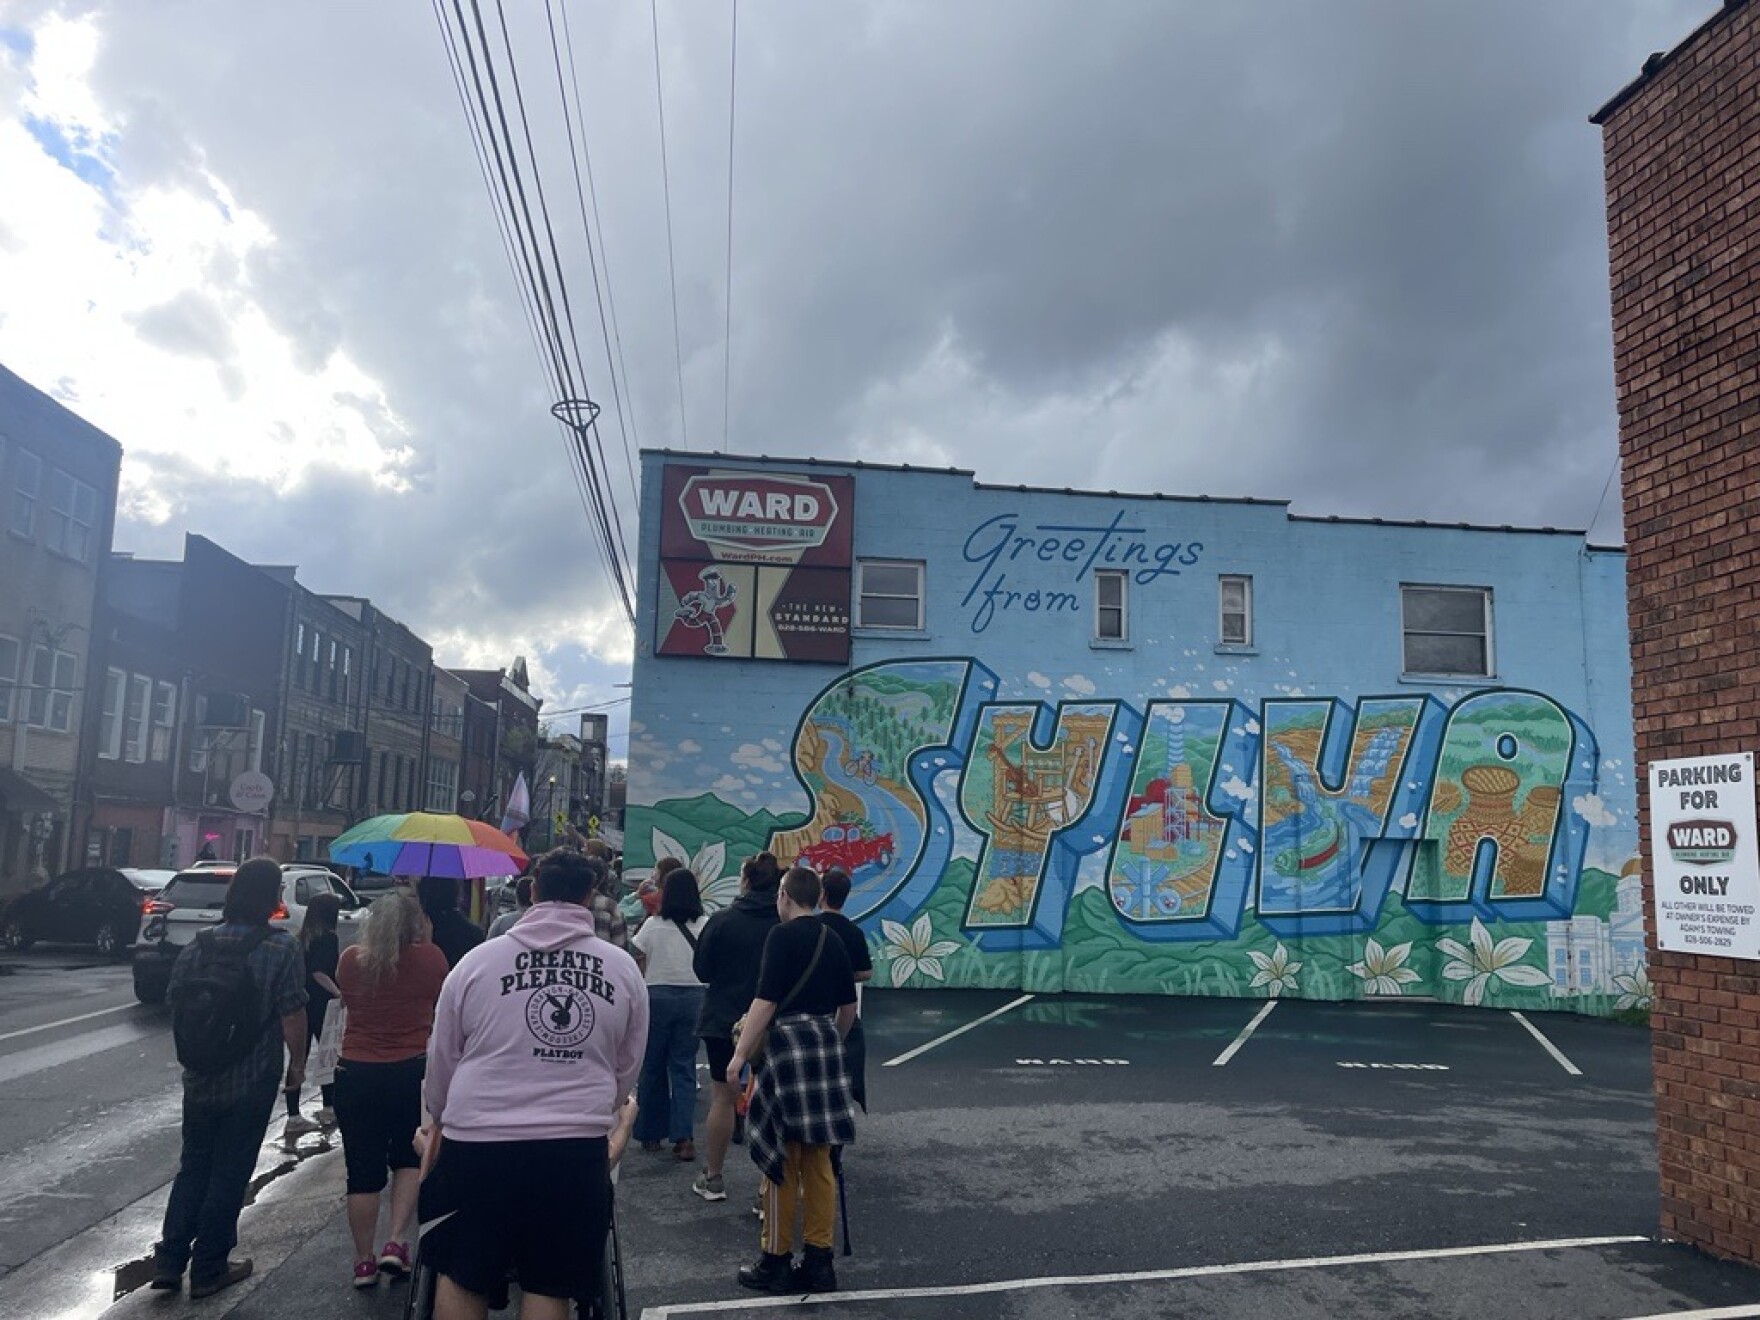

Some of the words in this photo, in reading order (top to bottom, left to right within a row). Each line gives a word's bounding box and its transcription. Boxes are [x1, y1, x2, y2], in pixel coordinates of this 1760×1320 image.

[698, 488, 819, 521] WARD
[701, 523, 747, 534] PLUMBING
[754, 526, 793, 536] HEATING
[799, 528, 815, 537] AIR
[721, 552, 793, 563] WardPH.com
[962, 510, 1204, 606] Greetings
[971, 574, 1080, 633] from
[775, 613, 849, 625] STANDARD
[1658, 763, 1742, 788] PARKING
[768, 656, 1594, 950] SYLVA
[1680, 790, 1719, 810] FOR
[1673, 828, 1730, 846] WARD
[1679, 875, 1730, 896] ONLY
[1661, 901, 1673, 910] ALL
[1674, 902, 1697, 911] OTHER
[1698, 903, 1714, 911] WILL
[1716, 904, 1725, 913] BE
[1727, 904, 1755, 915] TOWED
[1665, 912, 1673, 920] AT
[1675, 912, 1705, 922] OWNER'S
[1707, 914, 1739, 925] EXPENSE
[1741, 916, 1751, 925] BY
[1707, 925, 1737, 936] TOWING
[515, 950, 604, 977] CREATE
[500, 969, 615, 1006] PLEASURE
[533, 1048, 584, 1060] PLAYBOY
